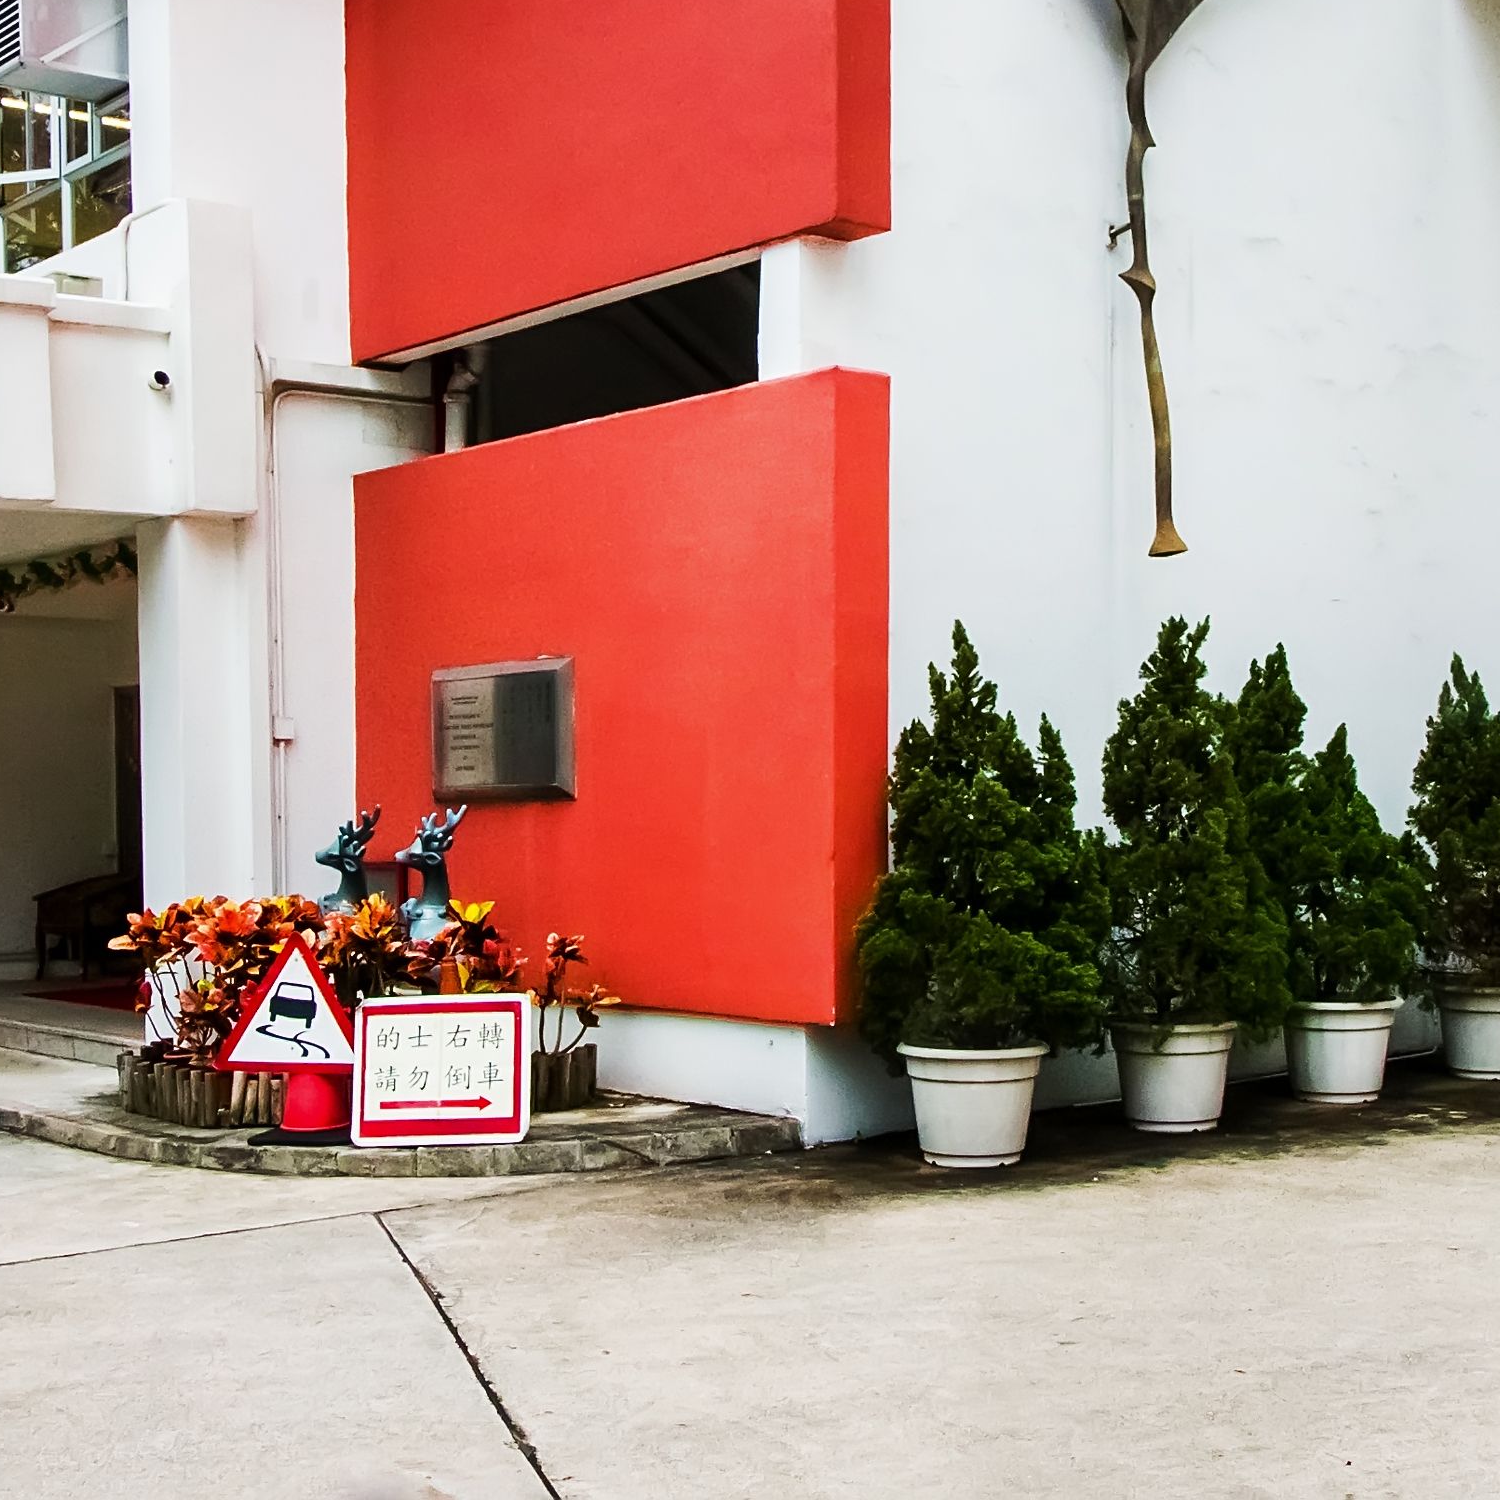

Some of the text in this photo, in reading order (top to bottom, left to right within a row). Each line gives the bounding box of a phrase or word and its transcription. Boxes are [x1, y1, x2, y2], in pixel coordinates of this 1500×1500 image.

[376, 1023, 505, 1050] 的士右轉
[374, 1061, 505, 1092] 請勿倒車
